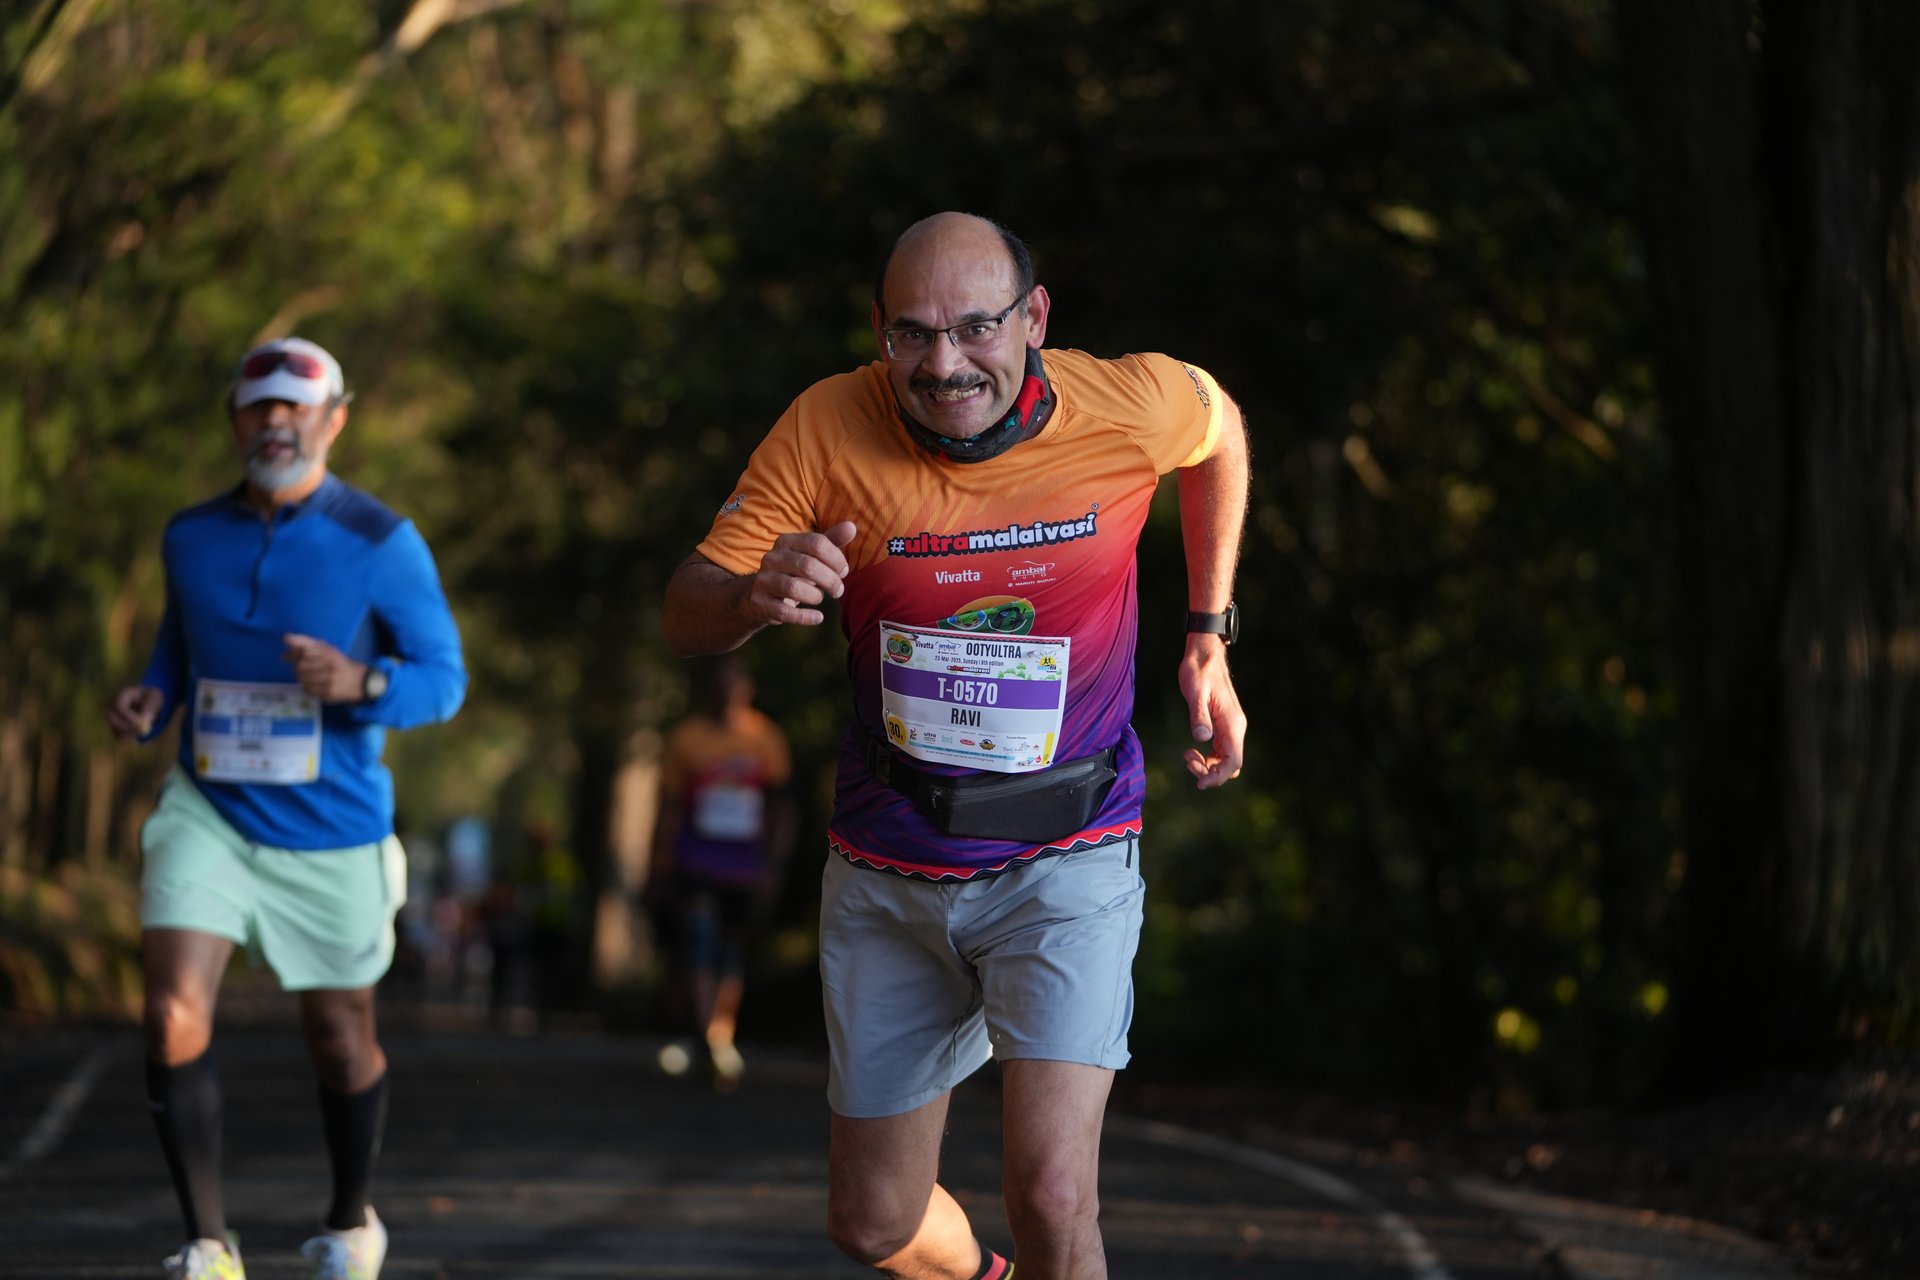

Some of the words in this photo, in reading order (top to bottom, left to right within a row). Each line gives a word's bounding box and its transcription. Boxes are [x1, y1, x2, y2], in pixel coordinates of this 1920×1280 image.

[889, 513, 1096, 556] #ultramalaivasi
[935, 570, 980, 584] Vivatta
[1012, 564, 1046, 576] ambal
[915, 640, 934, 650] Vivatta
[966, 642, 1021, 659] OOTYULTRA
[938, 677, 998, 705] T-0570
[951, 708, 981, 727] RAVI
